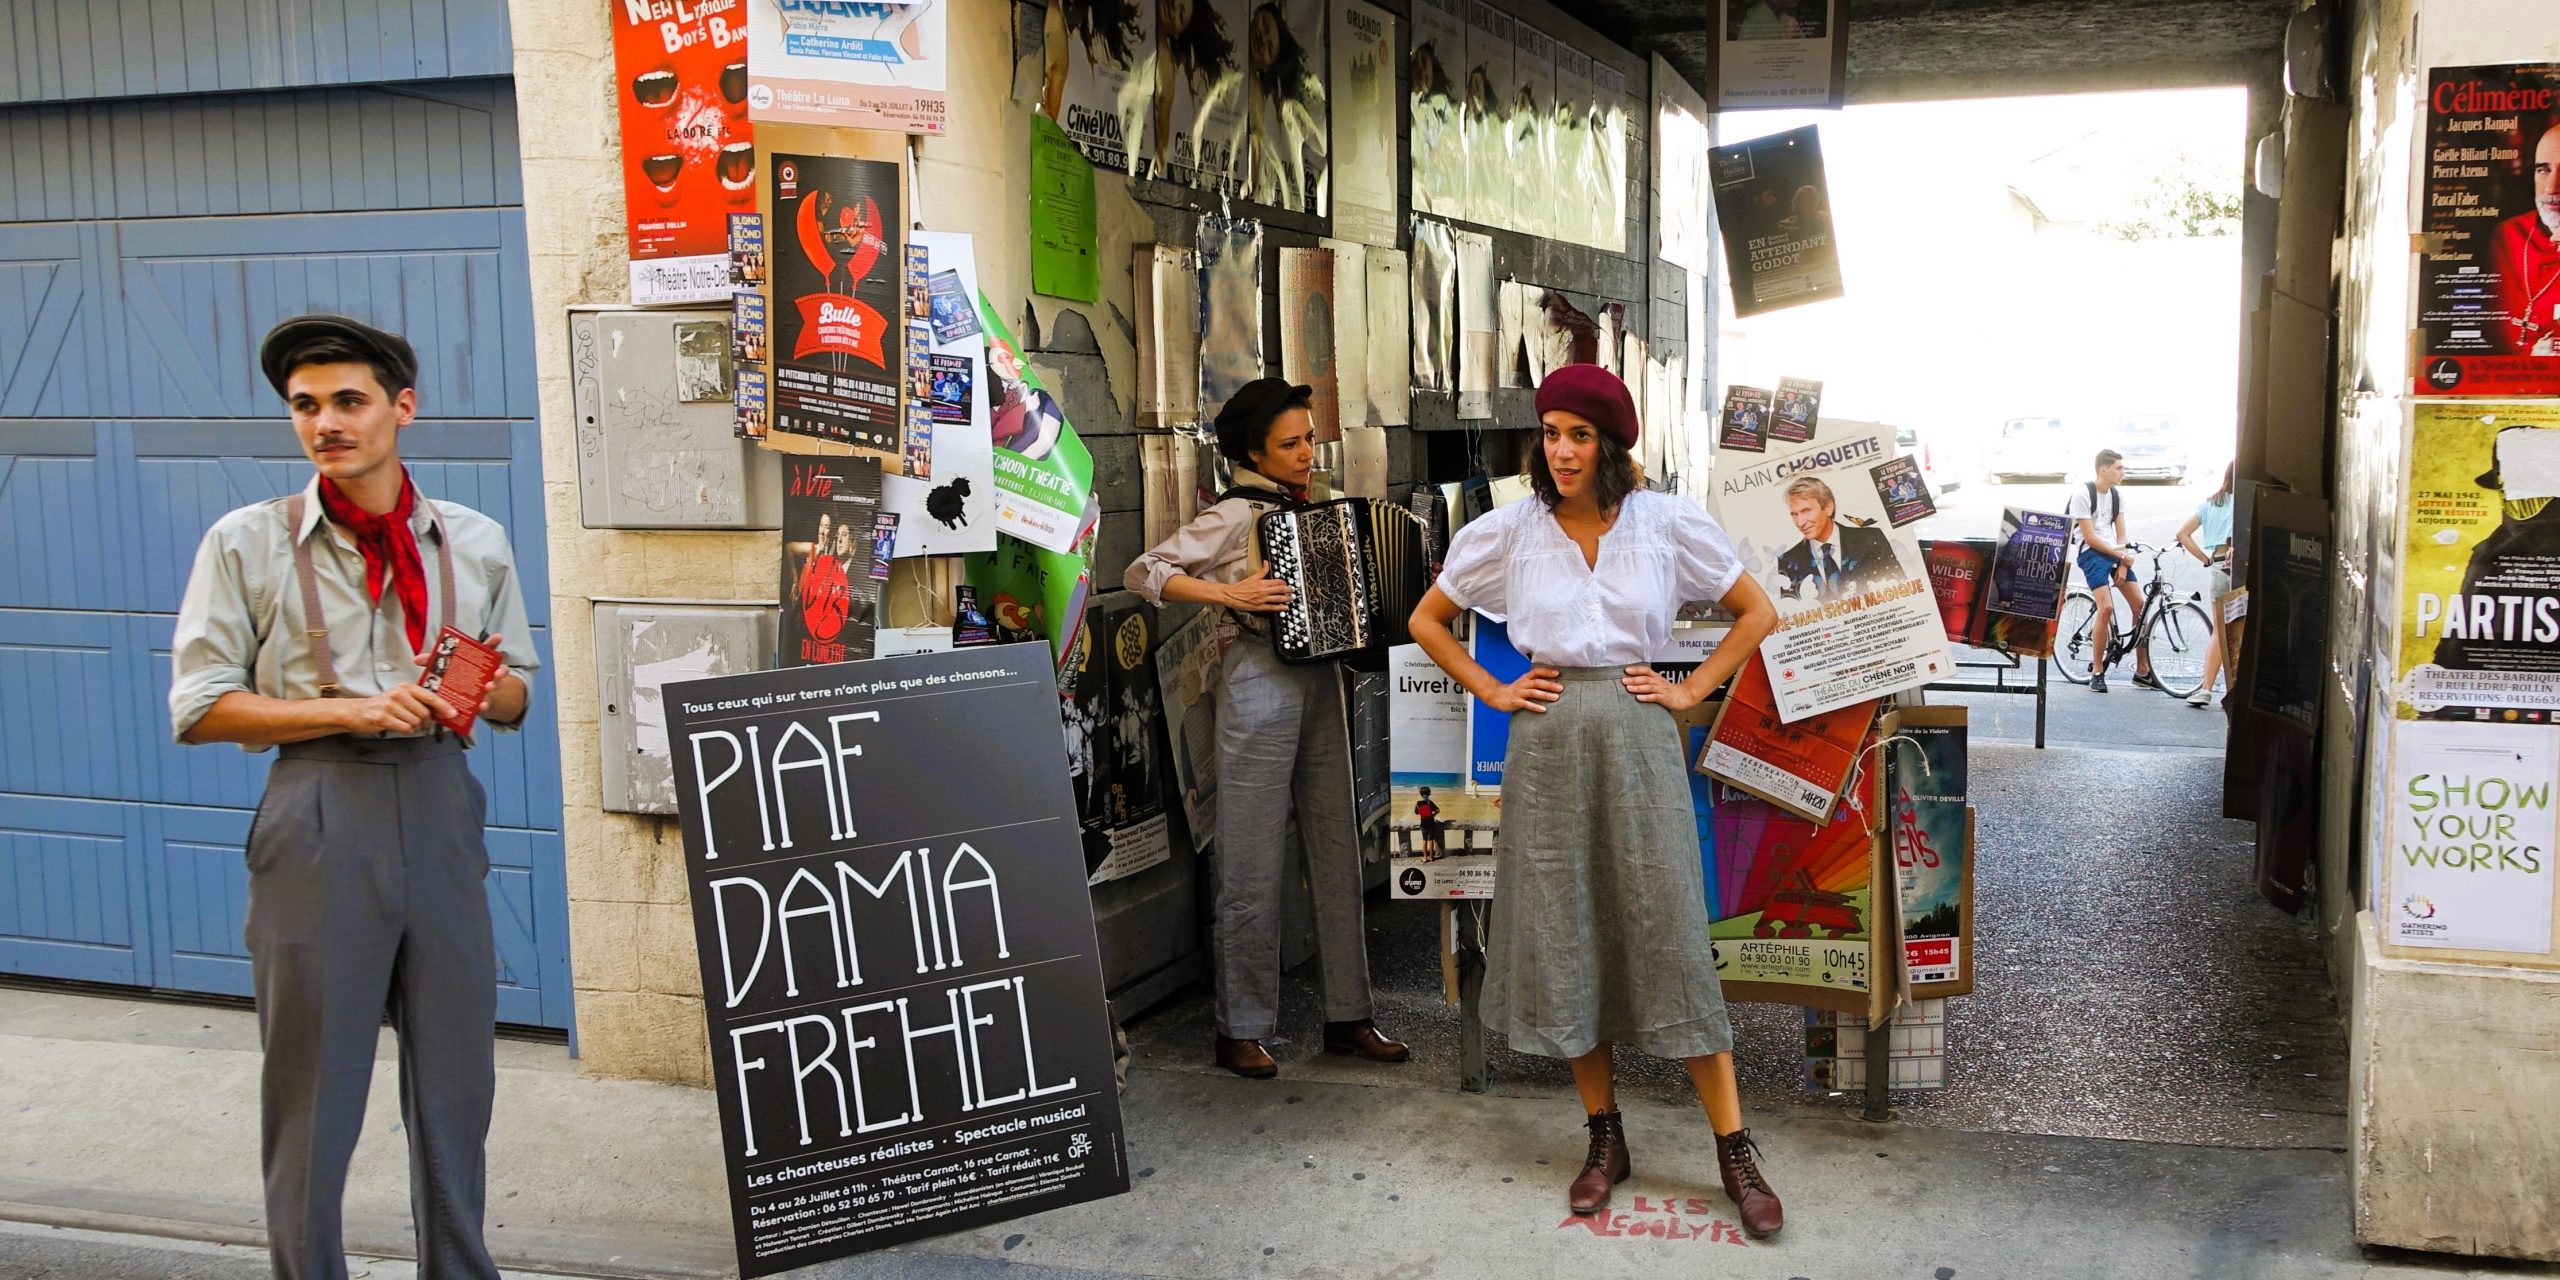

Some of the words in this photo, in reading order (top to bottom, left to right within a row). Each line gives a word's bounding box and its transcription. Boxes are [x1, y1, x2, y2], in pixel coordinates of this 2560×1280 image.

[800, 36, 840, 49] Catherine
[841, 41, 864, 51] Arditi
[776, 89, 811, 102] Théâtre
[814, 93, 825, 104] La
[828, 94, 850, 105] Luna
[914, 99, 946, 114] 19H35
[2434, 81, 2551, 114] Célimène
[2448, 117, 2483, 134] Jacques
[2484, 115, 2518, 133] Rampal
[2432, 166, 2459, 178] Pierre
[2432, 193, 2457, 206] Pascal
[2457, 193, 2480, 206] Faber
[1748, 237, 1766, 250] EN
[1750, 235, 1828, 262] ATTENDANT
[1752, 253, 1800, 273] GODOT
[818, 302, 861, 326] Bulle
[1724, 468, 1773, 497] ALAIN
[1776, 436, 1880, 479] CHOQUETTE
[806, 464, 833, 498] Vie
[2434, 491, 2452, 499] MAI
[2417, 508, 2441, 516] POUR
[2445, 508, 2488, 517] RÉSISTER
[1933, 553, 1976, 569] OSCAR
[2020, 542, 2061, 564] HORS
[1932, 564, 1973, 581] WILDE
[2026, 560, 2058, 580] TEMPS
[1769, 607, 1824, 636] NE-MAN
[1863, 579, 1925, 609] MAGIQUE
[801, 639, 810, 660] EN
[812, 641, 846, 663] CONCERT
[1686, 640, 1702, 648] PLACE
[1404, 661, 1436, 669] Christophe
[1400, 676, 1449, 694] Livret
[1813, 680, 1847, 698] THÉÂTRE
[1849, 678, 1861, 687] DU
[1863, 669, 1892, 684] CHÊNE
[1893, 662, 1916, 675] NOIR
[2425, 670, 2476, 680] THEATRE
[2478, 672, 2500, 681] DES
[682, 702, 714, 714] Tous
[717, 698, 749, 711] ceux
[751, 693, 773, 709] qui
[776, 692, 796, 704] sur
[799, 688, 832, 701] terre
[871, 679, 897, 695] plus
[900, 678, 923, 691] que
[926, 674, 947, 685] des
[2445, 682, 2467, 690] RUE
[2470, 682, 2553, 693] LEDRU-ROLLIN
[1743, 757, 1800, 786] RESERVATION
[689, 711, 881, 859] PIAF
[2408, 773, 2549, 812] SHOW
[1800, 789, 1827, 810] 14H20
[1912, 794, 1937, 802] OLIVIER
[2412, 813, 2517, 842] YOUR
[2402, 843, 2541, 874] WORKS
[709, 842, 1010, 1008] DAMIA
[2401, 922, 2448, 931] GATHERING
[2401, 928, 2435, 937] ARTISTS
[1740, 941, 1810, 957] ARTÉPHILE
[1924, 948, 1949, 956] 15h45
[1740, 953, 1752, 962] 04
[1755, 953, 1767, 963] 90
[1770, 954, 1781, 964] 03
[1785, 955, 1795, 965] 01
[1798, 957, 1810, 966] 90
[1823, 948, 1865, 971] 10h45
[730, 976, 1077, 1157] FREHEL
[747, 1172, 773, 1188] Les
[777, 1154, 867, 1180] chanteuses
[870, 1138, 935, 1162] réalistes
[954, 1118, 1028, 1145] Spectacle
[1030, 1104, 1086, 1127] musical
[1068, 1141, 1093, 1159] OFF
[751, 1205, 766, 1216] Du
[768, 1204, 776, 1212] 4
[778, 1201, 792, 1210] au
[794, 1197, 807, 1206] 26
[808, 1188, 840, 1204] Juillet
[843, 1185, 850, 1195] à
[851, 1183, 868, 1194] 11h
[880, 1170, 922, 1187] Théâtre
[924, 1163, 963, 1178] Carnot,
[964, 1160, 975, 1169] 16
[977, 1156, 993, 1167] rue
[995, 1149, 1030, 1162] Carnot
[823, 1203, 836, 1214] 06
[838, 1200, 850, 1210] 52
[853, 1197, 865, 1207] 50
[868, 1193, 880, 1204] 65
[882, 1190, 895, 1201] 70
[906, 1183, 930, 1195] Tarif
[932, 1177, 957, 1192] plein
[958, 1172, 977, 1184] 16€
[986, 1164, 1010, 1177] Tarif
[1012, 1158, 1041, 1172] réduit
[1043, 1153, 1060, 1165] 11€
[1633, 1196, 1712, 1216] LES
